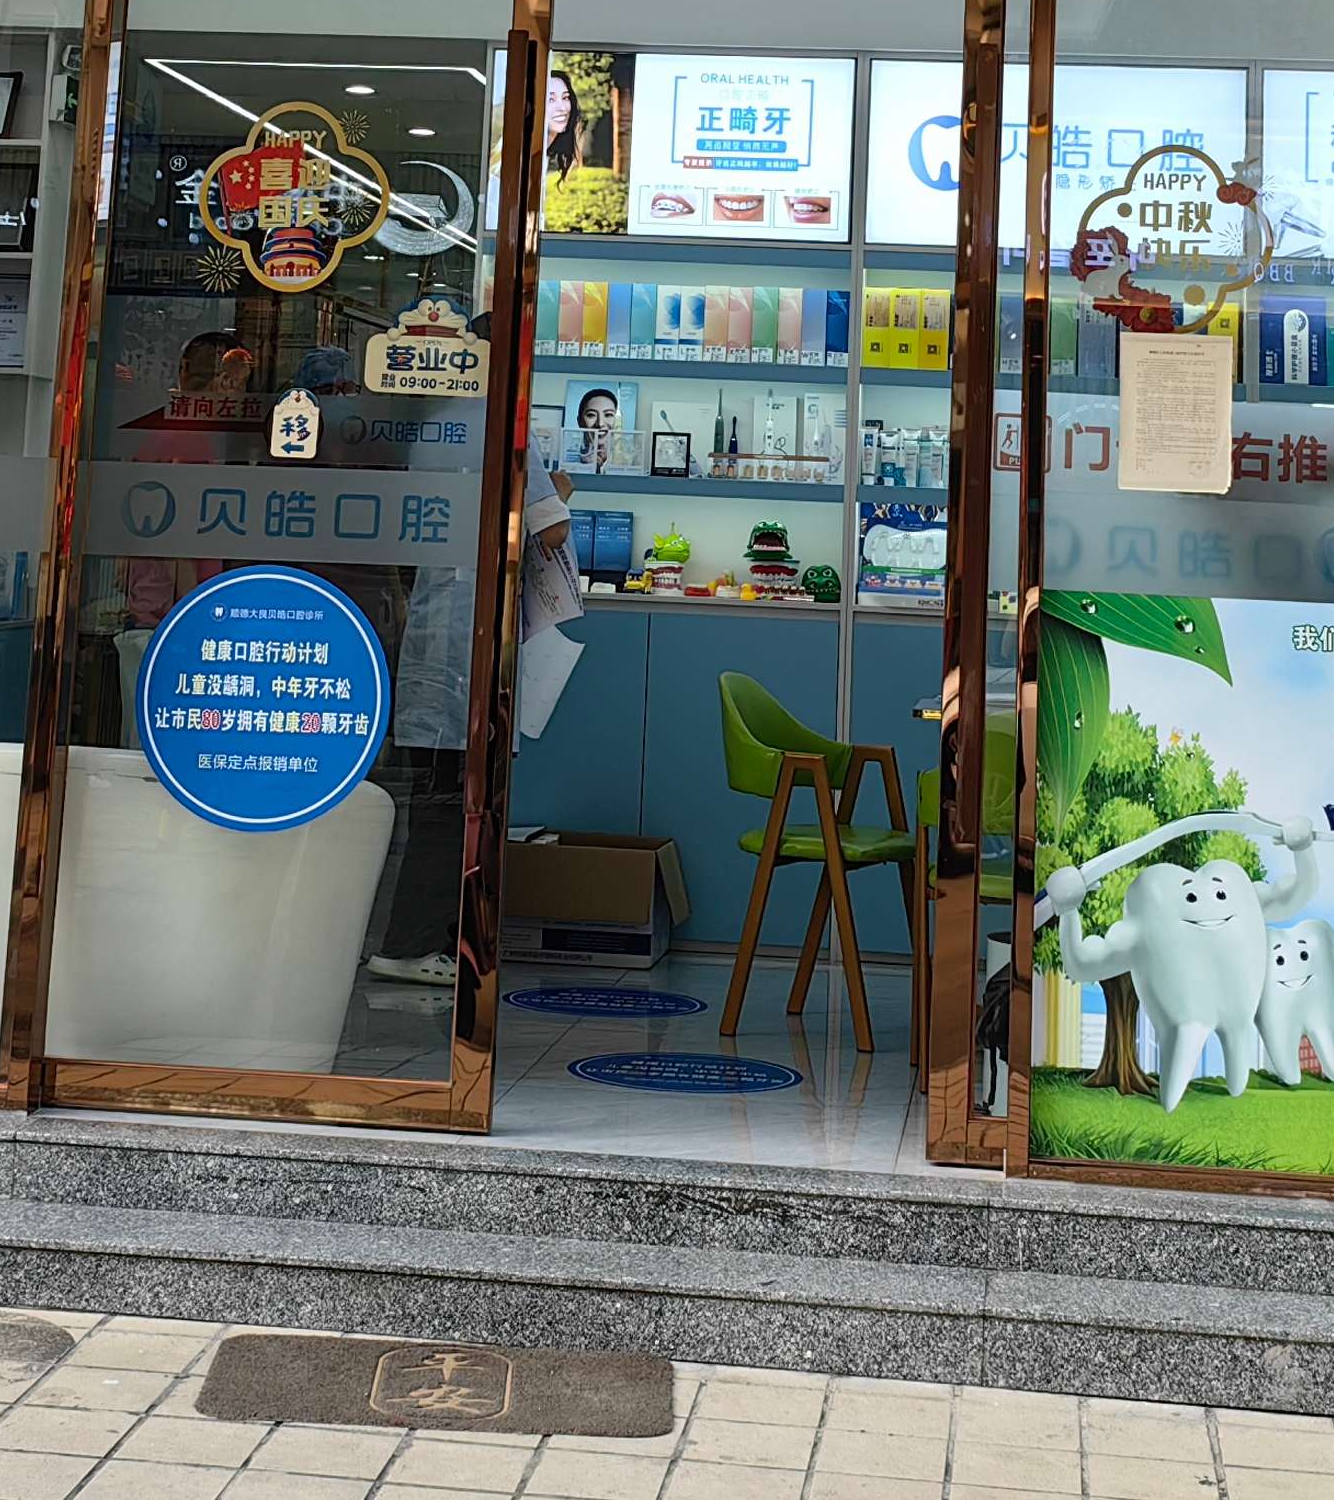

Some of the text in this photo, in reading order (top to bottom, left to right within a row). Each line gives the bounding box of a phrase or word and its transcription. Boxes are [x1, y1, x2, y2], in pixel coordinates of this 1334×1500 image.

[701, 73, 789, 85] ORAL HEALTH
[696, 106, 791, 135] 正畸牙
[265, 130, 327, 149] HAPPY
[259, 158, 331, 191] 喜迎
[1055, 174, 1137, 192] 隐形矫
[1143, 173, 1207, 192] HAPPY
[258, 195, 330, 228] 国庆
[1139, 201, 1213, 233] 中秋
[385, 344, 479, 375] 营业中
[169, 396, 263, 418] 请向左拉
[279, 414, 311, 442] 移
[370, 420, 467, 444] 贝皓口腔
[1064, 422, 1328, 483] 门右推
[196, 487, 451, 544] 贝皓口腔
[200, 638, 329, 666] 健康口腔行动计划
[154, 706, 370, 737] 让市民80岁拥有健康20颗牙齿
[198, 753, 319, 774] 医保定点报销单位
